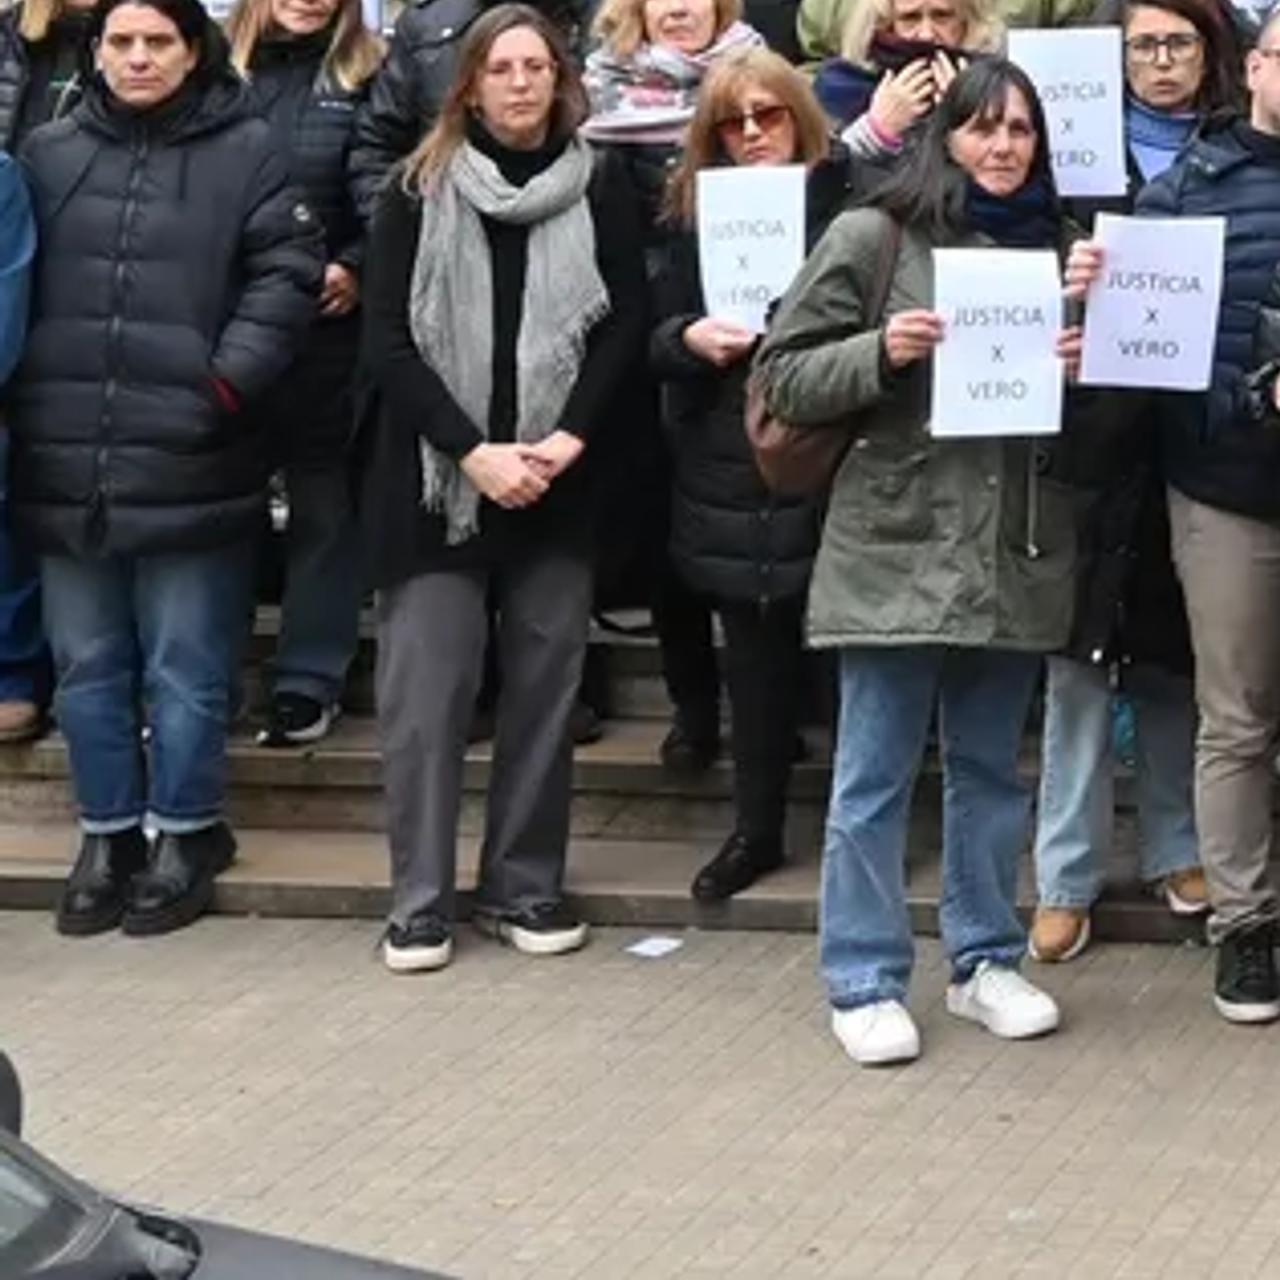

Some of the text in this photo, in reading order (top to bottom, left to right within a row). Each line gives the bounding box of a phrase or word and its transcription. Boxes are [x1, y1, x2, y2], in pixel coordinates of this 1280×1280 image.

[1042, 81, 1106, 101] STICIA
[737, 254, 748, 269] X
[1107, 272, 1202, 294] JUSTICIA
[954, 305, 1046, 327] JUSTICIA
[1145, 309, 1158, 323] X
[991, 346, 1004, 363] X
[1117, 340, 1179, 360] VERO
[967, 380, 1028, 401] VERO
